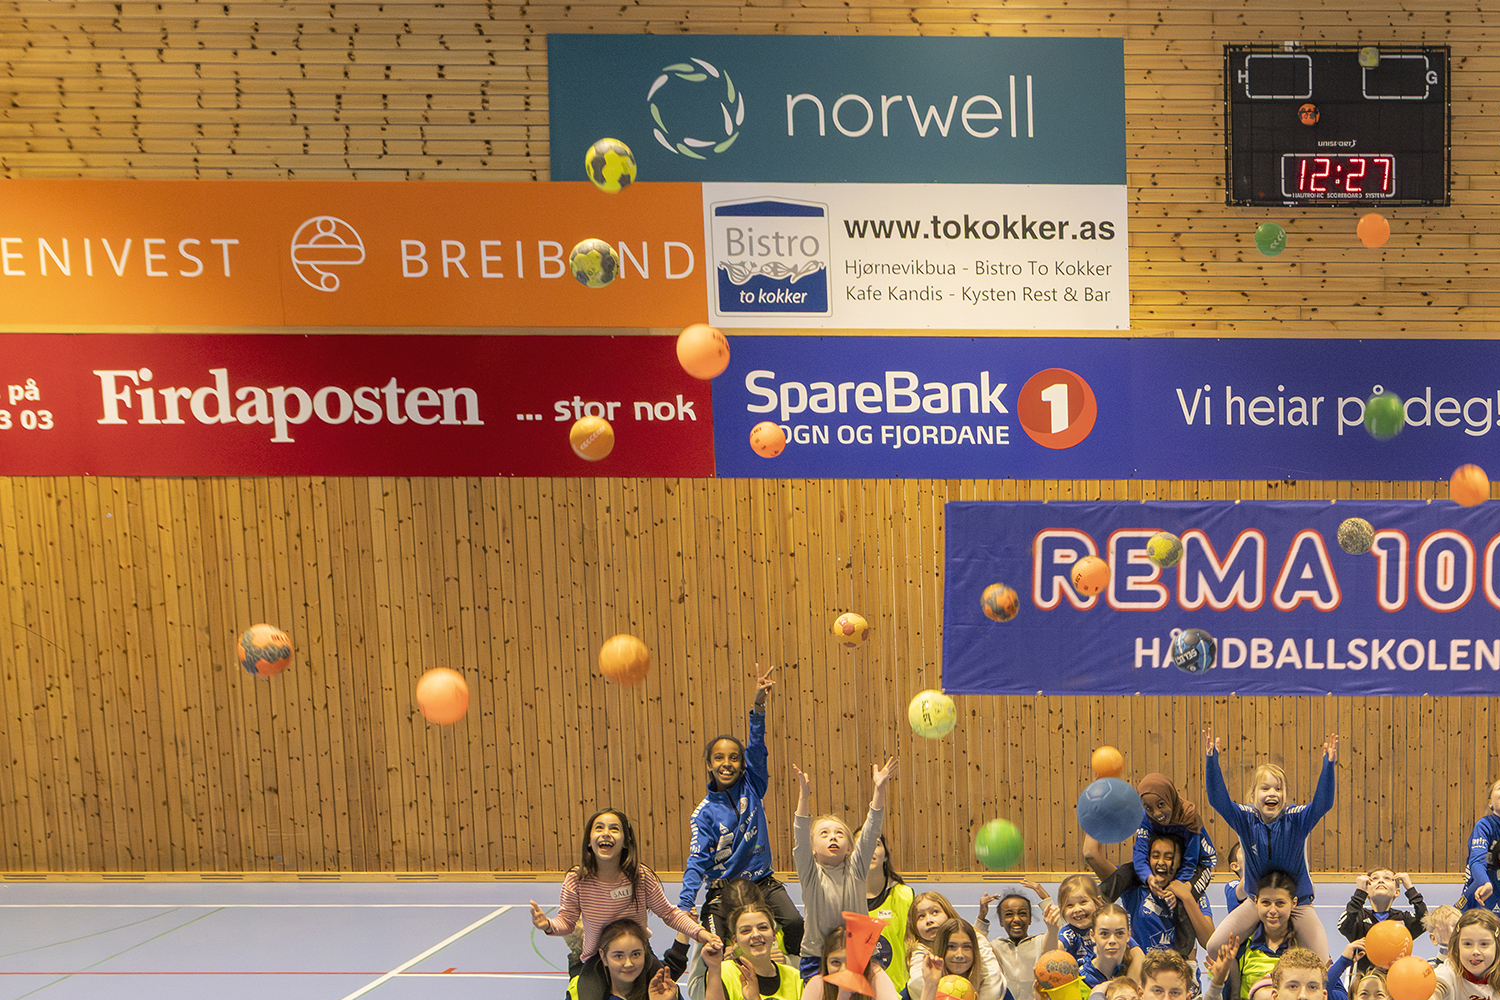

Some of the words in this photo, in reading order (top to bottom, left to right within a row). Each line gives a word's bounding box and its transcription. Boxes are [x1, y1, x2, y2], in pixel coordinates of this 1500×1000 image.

[1238, 70, 1248, 83] H
[1426, 71, 1438, 84] G
[787, 75, 1033, 138] norwell
[1299, 158, 1390, 192] 12:27
[725, 227, 820, 258] Bistro
[844, 215, 1115, 240] www.tokokker.as
[1, 238, 239, 277] ENIVEST
[401, 240, 695, 279] BREIBND
[845, 260, 956, 279] Hjørnevikbua
[975, 260, 1021, 275] Bistro
[1027, 260, 1049, 275] To
[1056, 260, 1110, 275] Kokker
[739, 290, 755, 304] to
[759, 288, 808, 304] kokker
[846, 285, 882, 300] Kafe
[889, 285, 943, 300] Kandis
[962, 286, 1016, 305] Kysten
[1022, 286, 1058, 301] Rest
[1063, 286, 1078, 301] &
[1084, 286, 1110, 301] Bar
[8, 378, 40, 405] på
[93, 367, 484, 442] Firdaposten
[554, 396, 622, 421] stor
[634, 395, 696, 421] nok
[745, 370, 1009, 421] SpareBank
[1042, 384, 1069, 434] 1
[20, 410, 54, 430] 03
[1176, 385, 1212, 425] Vi
[1226, 384, 1325, 426] heiar
[1338, 384, 1393, 435] p
[760, 425, 830, 445] OGN
[837, 425, 873, 445] OG
[880, 425, 1010, 449] FJORDANE
[1032, 527, 1342, 611] REMA
[1135, 628, 1500, 671] HDBALLSKOLEN
